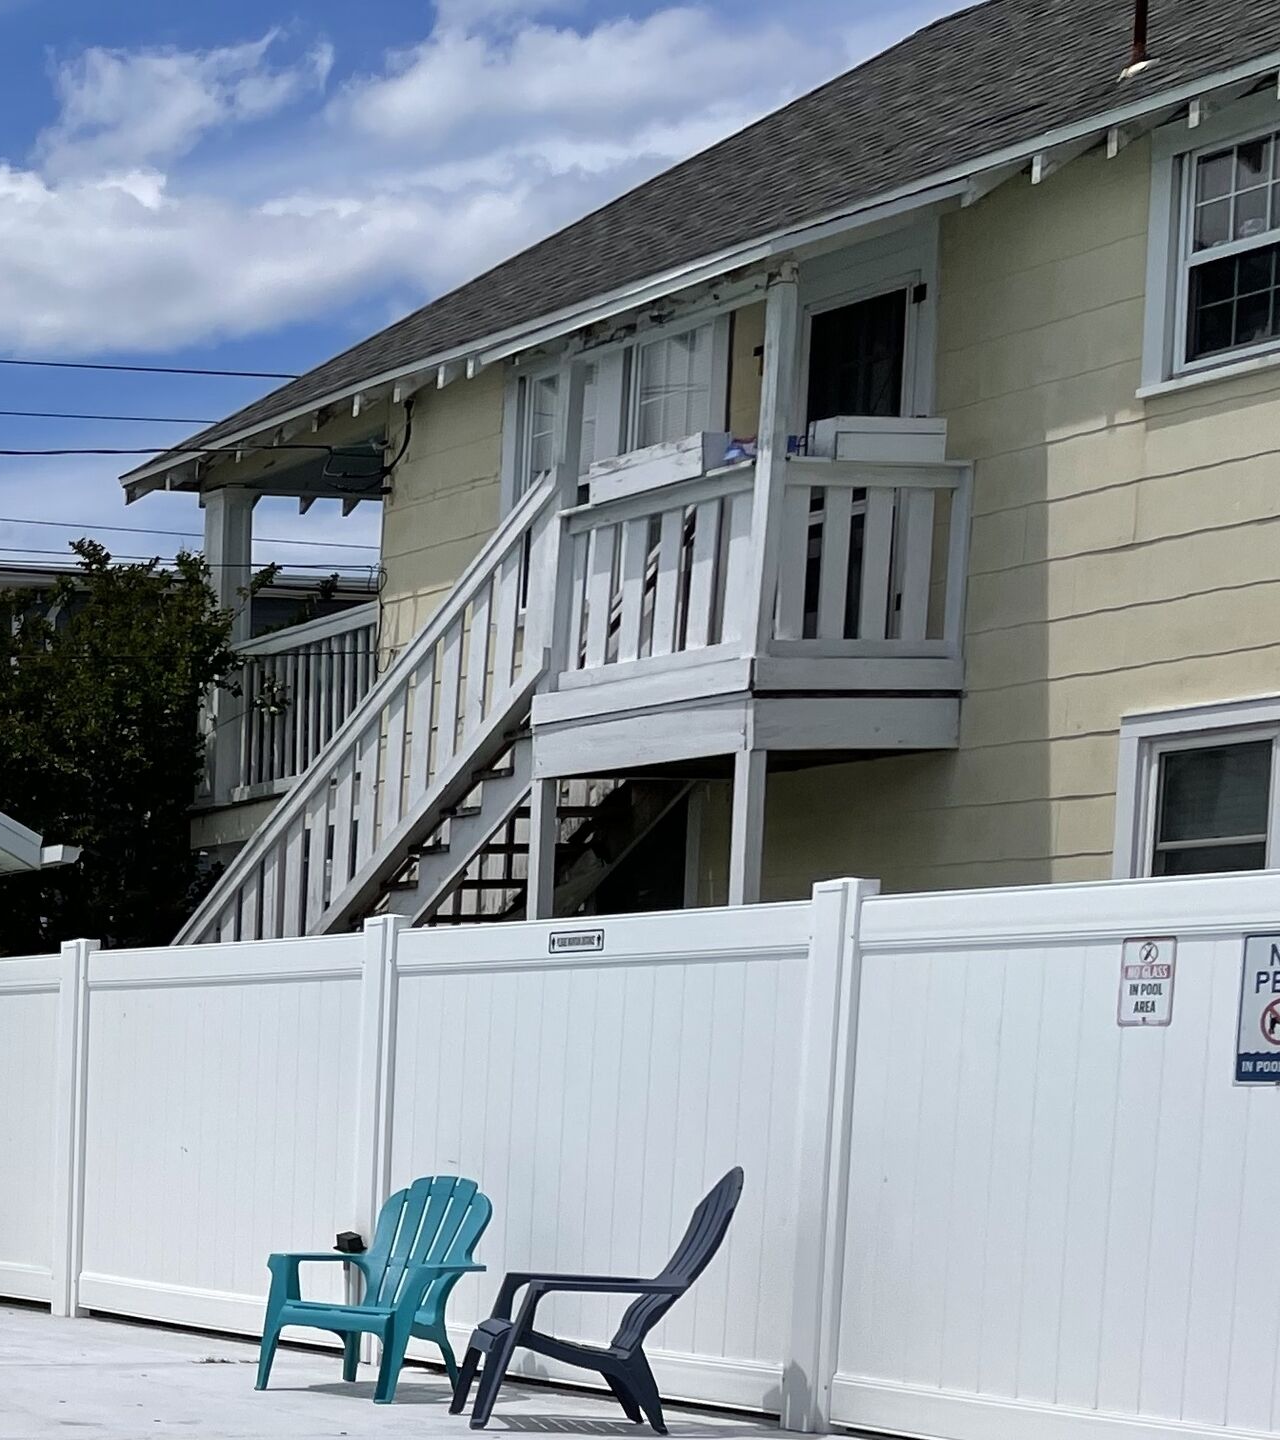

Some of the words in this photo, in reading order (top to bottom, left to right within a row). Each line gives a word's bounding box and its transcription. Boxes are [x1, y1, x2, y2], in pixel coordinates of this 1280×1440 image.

[1269, 943, 1280, 967] N
[1127, 966, 1139, 978] NO
[1141, 965, 1168, 978] GLASS
[1255, 971, 1280, 994] PE
[1129, 983, 1139, 996] IN
[1140, 983, 1163, 996] POOL
[1132, 1000, 1156, 1014] AREA
[1241, 1060, 1253, 1073] IN
[1256, 1060, 1280, 1073] POO
